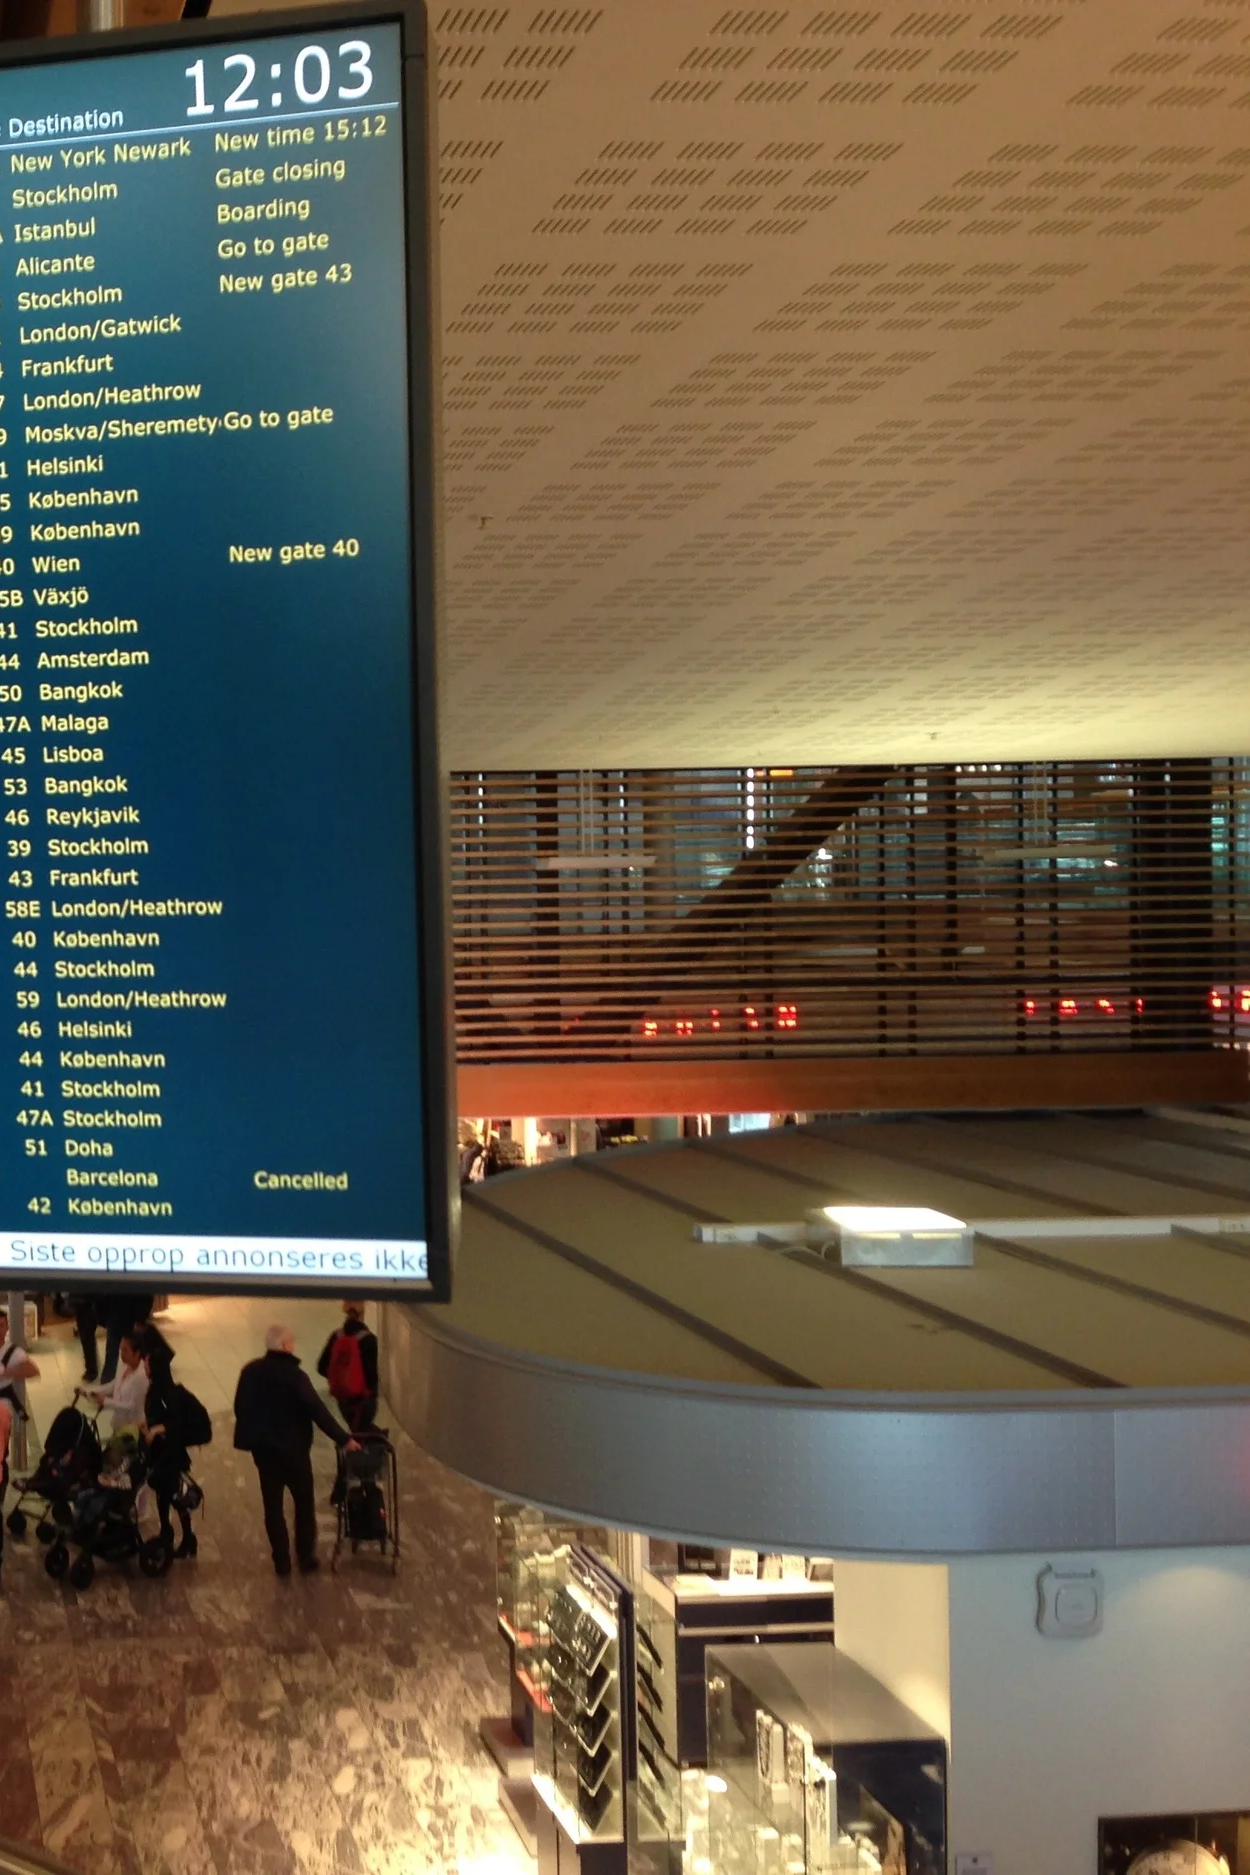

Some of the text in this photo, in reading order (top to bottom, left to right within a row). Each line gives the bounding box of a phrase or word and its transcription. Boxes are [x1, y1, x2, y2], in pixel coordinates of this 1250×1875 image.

[184, 39, 373, 117] 12:03
[7, 108, 124, 139] Destination
[10, 153, 54, 174] New
[59, 145, 106, 169] York
[112, 135, 192, 163] Newark
[214, 131, 259, 152] New
[266, 125, 315, 147] time
[324, 114, 387, 142] 15:12
[11, 180, 118, 209] Stockholm
[214, 166, 266, 188] Gate
[271, 157, 346, 183] closing
[13, 215, 96, 243] Istanbul
[216, 197, 311, 224] Boarding
[15, 253, 96, 277] Alicante
[217, 238, 247, 259] Go
[253, 236, 275, 255] to
[281, 231, 330, 257] gate
[16, 284, 123, 312] Stockholm
[218, 273, 264, 293] New
[270, 267, 318, 293] gate
[324, 262, 353, 283] 43
[19, 312, 182, 345] London/Gatwick
[20, 353, 115, 378] Frankfurt
[22, 382, 202, 412] London/Heathrow
[24, 414, 221, 444] Moskva/Sheremety
[222, 410, 253, 431] Go
[258, 409, 281, 428] to
[286, 405, 334, 430] gate
[26, 453, 104, 477] Helsinki
[27, 486, 139, 510] København
[29, 519, 141, 542] København
[30, 554, 81, 574] Wien
[228, 544, 273, 563] New
[278, 541, 326, 565] gate
[331, 537, 360, 558] 40
[32, 585, 90, 609] Växjö
[36, 647, 150, 669] Amsterdam
[38, 679, 124, 704] Bangkok
[40, 712, 110, 735] Malaga
[3, 777, 28, 796] 53
[43, 774, 128, 798] Bangkok
[3, 807, 30, 827] 46
[45, 805, 141, 829] Reykjavik
[7, 869, 34, 888] 43
[49, 867, 139, 887] Frankfurt
[4, 899, 42, 919] 58E
[50, 897, 223, 919] London/Heathrow
[11, 929, 37, 949] 40
[52, 928, 161, 948] København
[15, 990, 41, 1009] 59
[56, 989, 227, 1010] London/Heathrow
[16, 1019, 43, 1039] 46
[57, 1019, 133, 1039] Helsinki
[15, 1108, 54, 1127] 47A
[62, 1108, 163, 1128] Stockholm
[24, 1137, 48, 1157] 51
[63, 1138, 114, 1157] Doha
[65, 1167, 159, 1188] Barcelona
[252, 1169, 349, 1191] Cancelled
[26, 1196, 52, 1215] 42
[67, 1197, 173, 1217] København
[10, 1239, 77, 1264] Siste
[87, 1246, 184, 1272] opprop
[196, 1249, 363, 1271] annonseres
[376, 1249, 427, 1272] ikke
